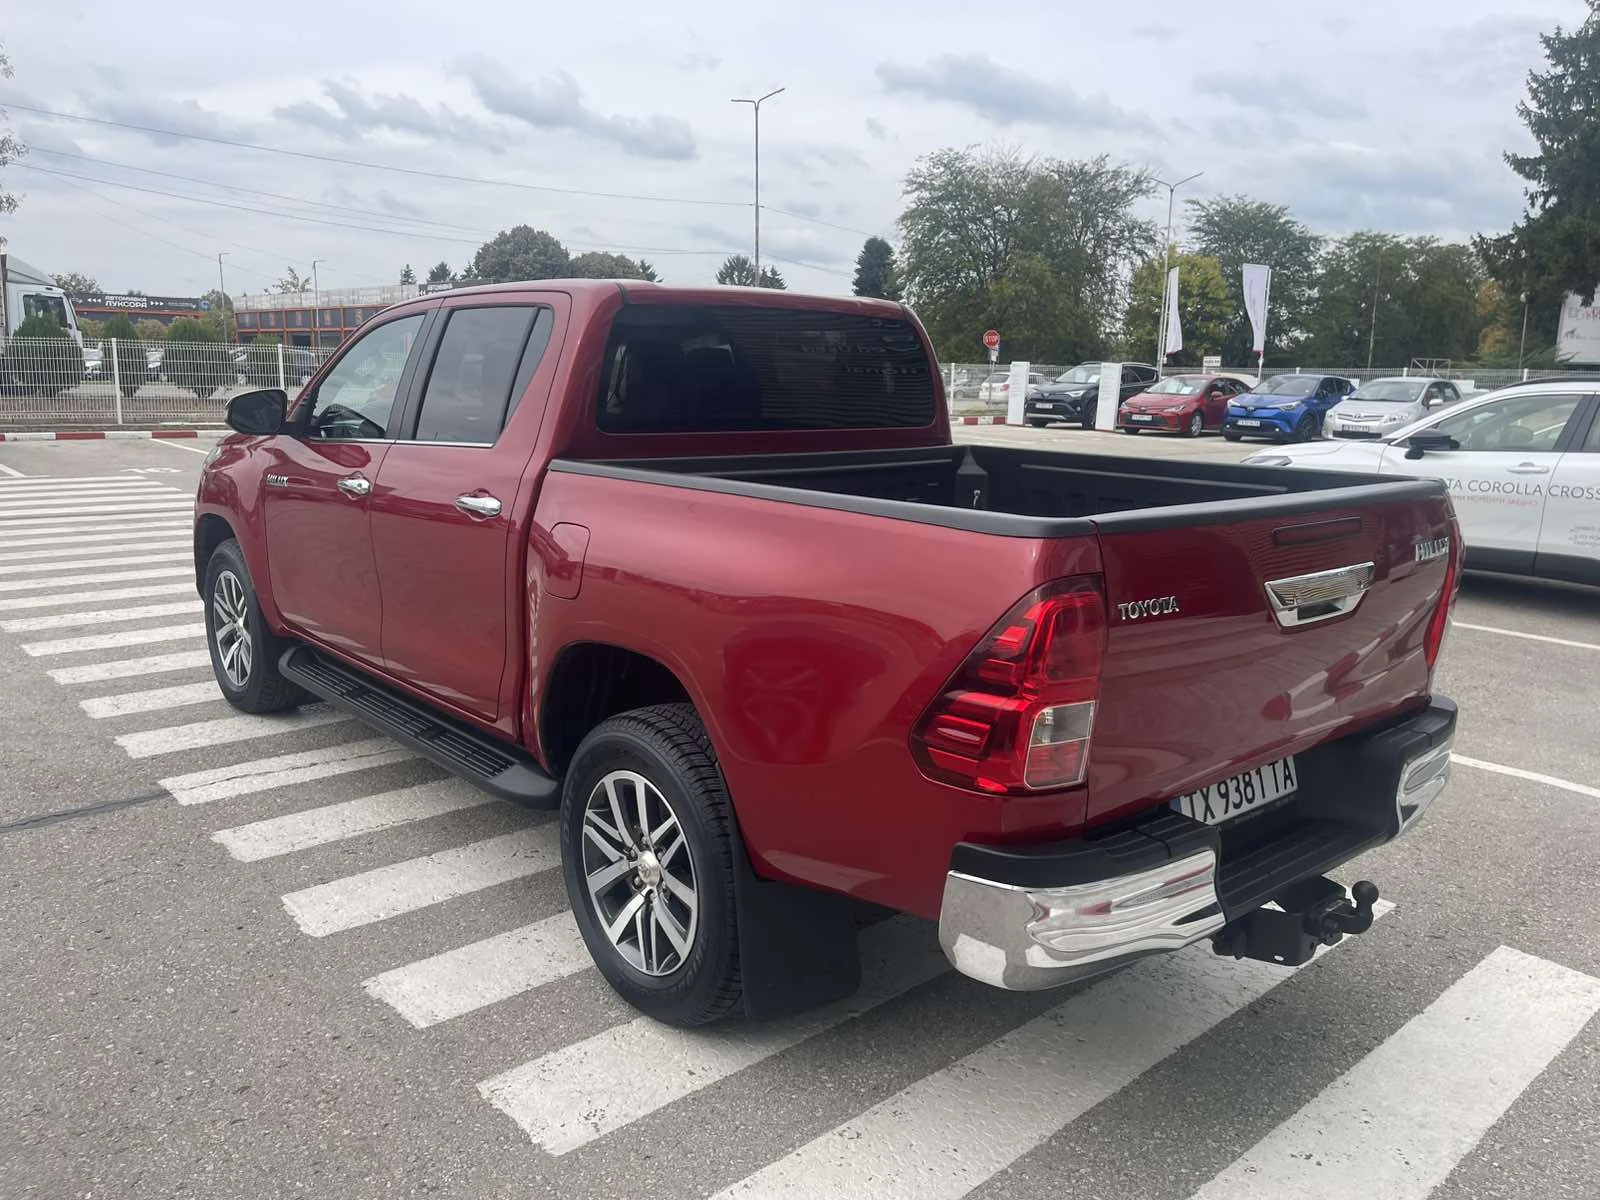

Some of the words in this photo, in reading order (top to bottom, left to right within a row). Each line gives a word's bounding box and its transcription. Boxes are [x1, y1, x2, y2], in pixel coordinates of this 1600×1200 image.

[105, 300, 148, 308] ЛУКСОРА
[985, 335, 998, 343] STOP
[1467, 479, 1543, 497] COROLLA
[1117, 595, 1180, 620] TOYOTA
[1217, 767, 1266, 816] 9381
[1267, 756, 1295, 794] TA
